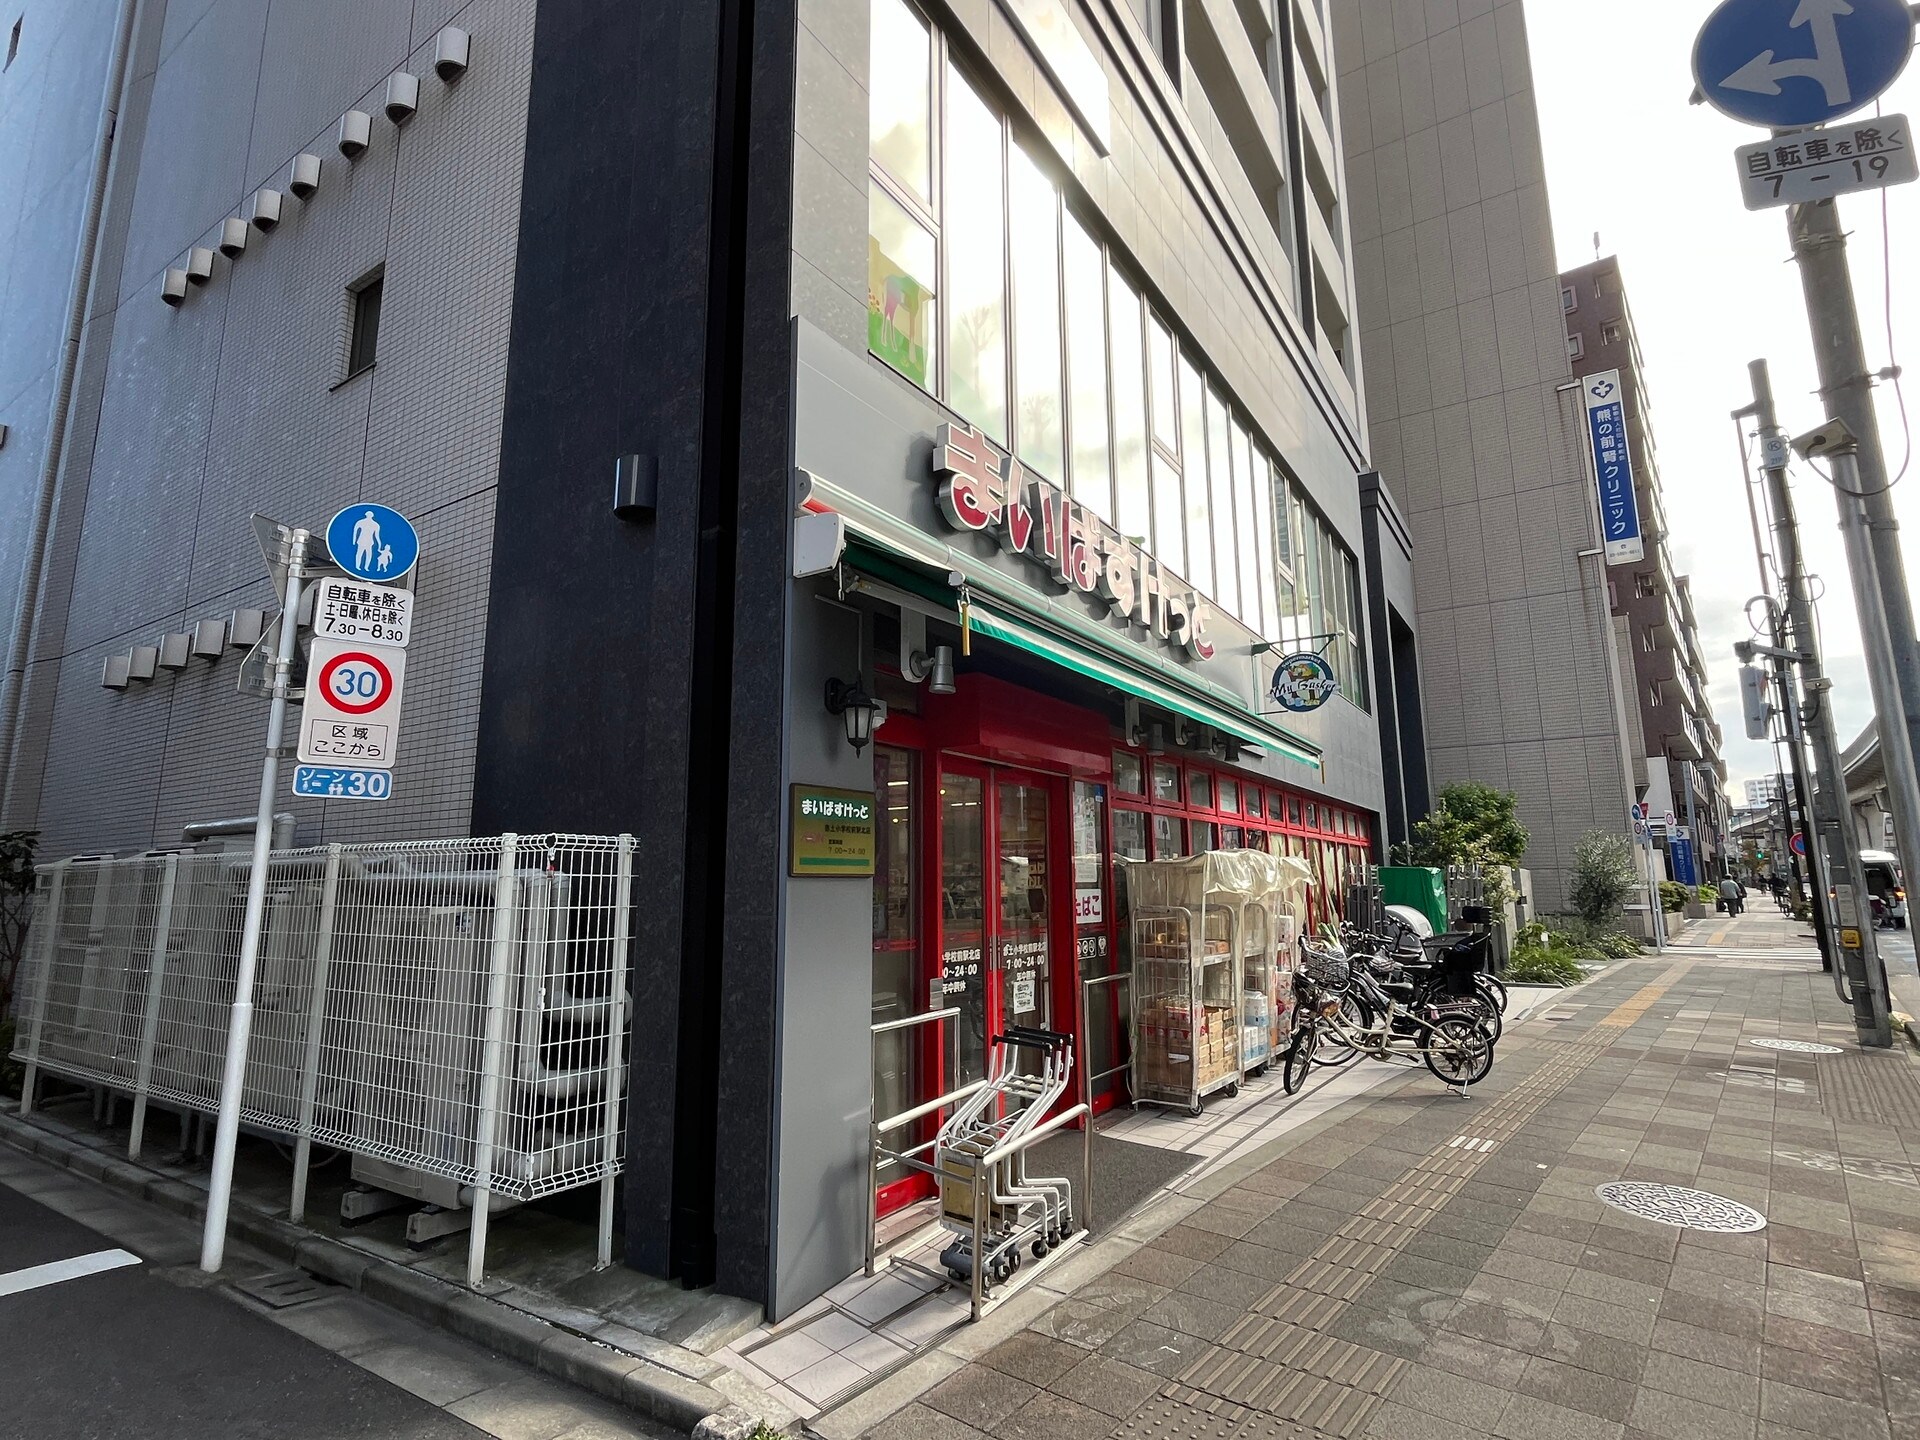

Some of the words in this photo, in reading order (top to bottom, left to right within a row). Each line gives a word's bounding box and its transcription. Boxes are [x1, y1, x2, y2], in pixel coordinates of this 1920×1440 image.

[1746, 128, 1903, 174] 自転車を除く
[938, 421, 1215, 662] まいばすけっと
[327, 585, 405, 609] 自転車を除く
[336, 668, 377, 698] 30
[332, 725, 369, 740] 区域
[314, 740, 381, 757] ここから
[801, 799, 869, 819] まいばすけっと
